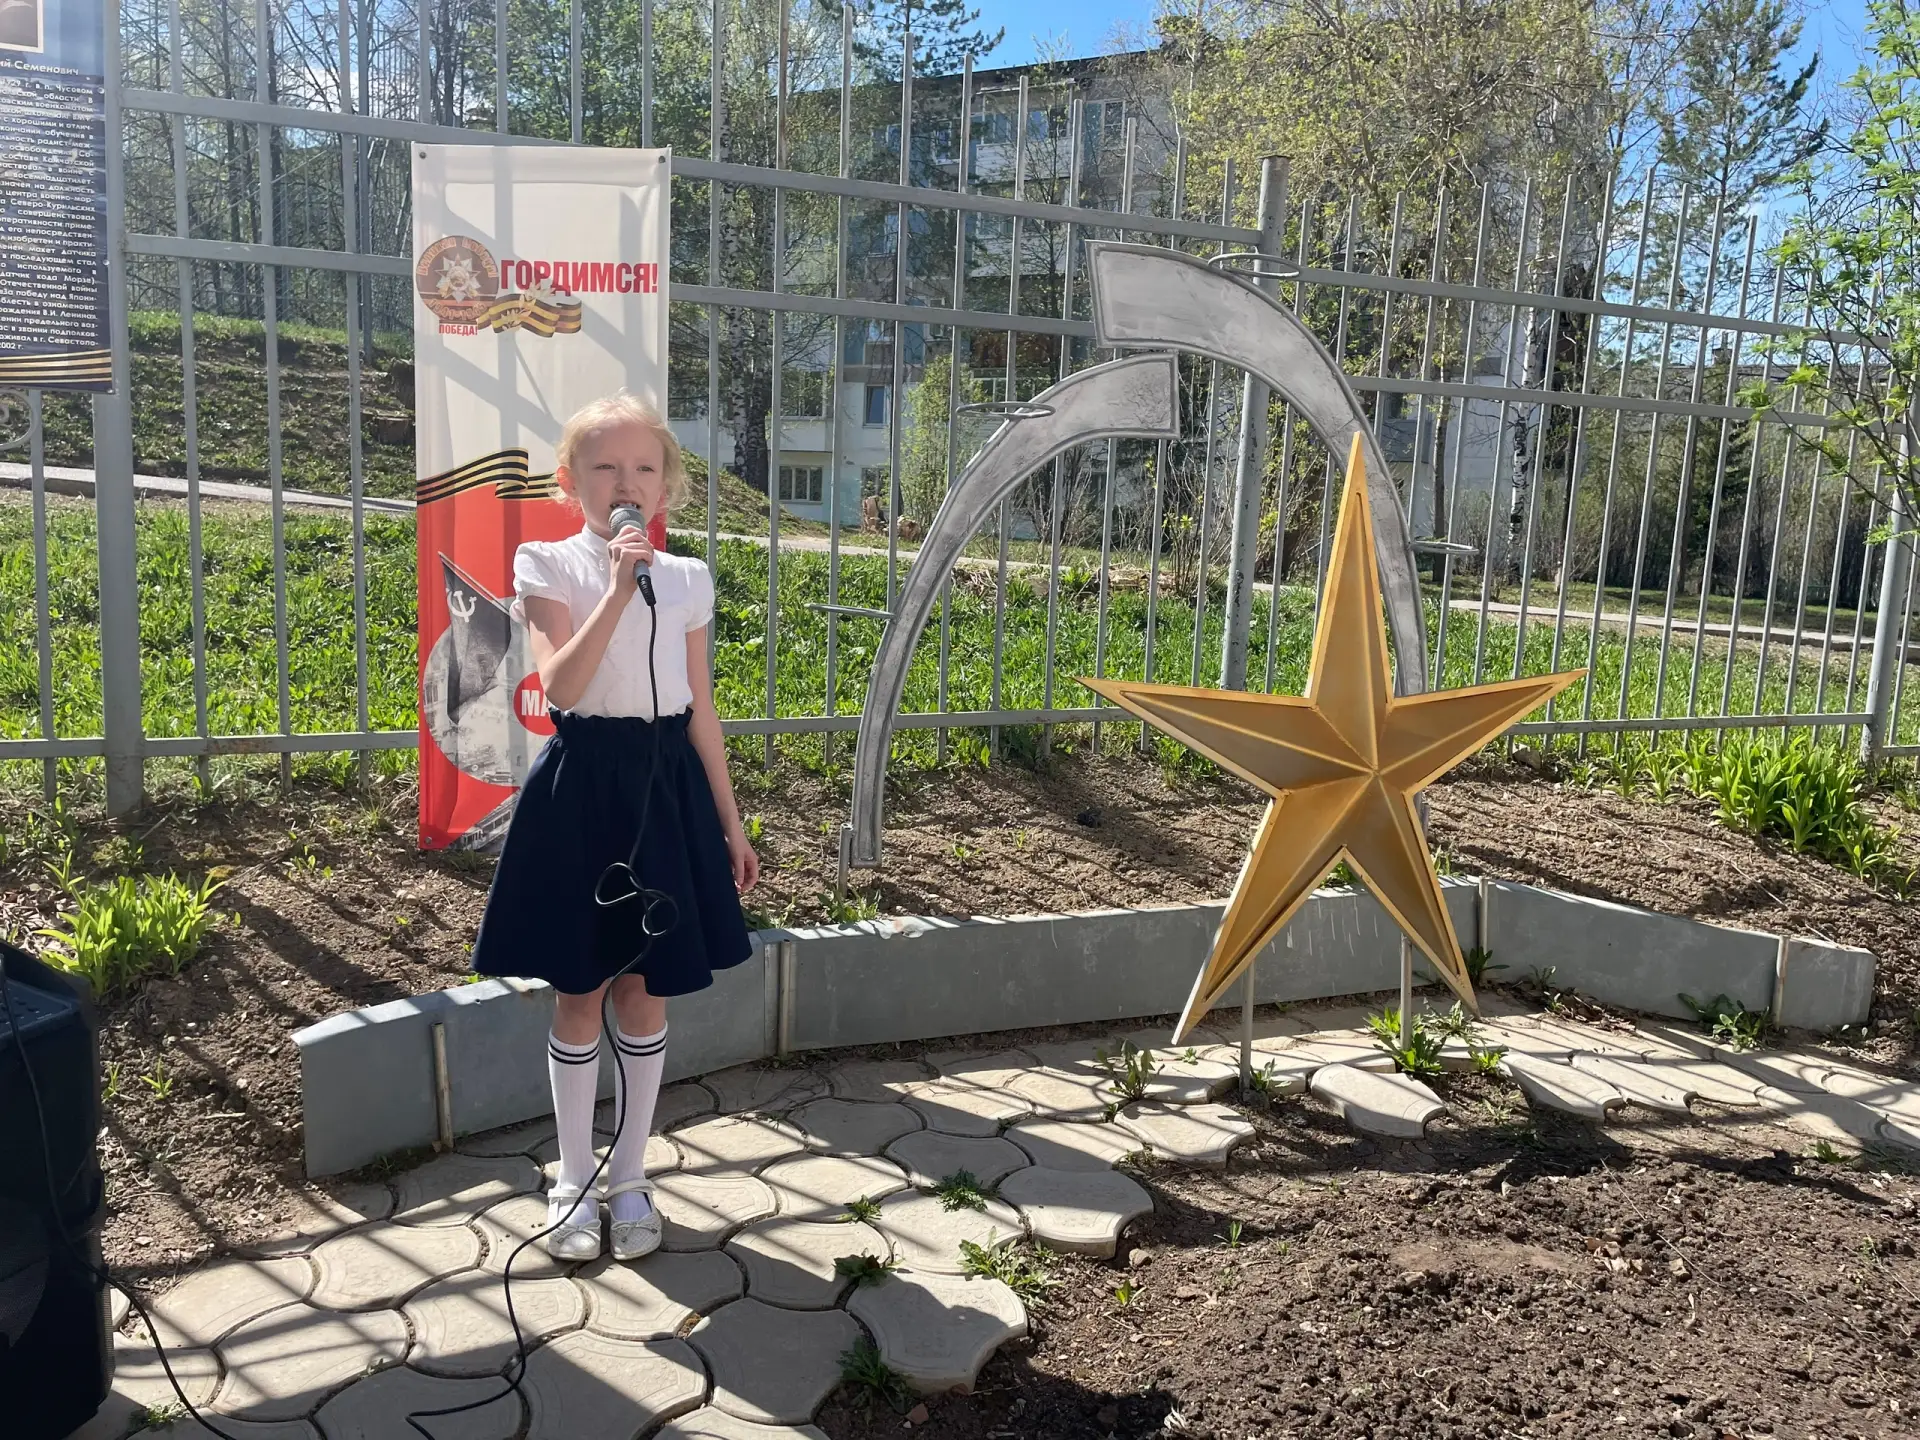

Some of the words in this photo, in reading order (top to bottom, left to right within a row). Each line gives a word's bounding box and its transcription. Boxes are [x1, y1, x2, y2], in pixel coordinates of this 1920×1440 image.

[14, 60, 79, 76] Семенович
[56, 84, 94, 95] Чусовом
[11, 118, 57, 128] хорошими
[45, 129, 85, 140] обучения
[6, 190, 38, 199] центра
[48, 184, 95, 195] должность
[10, 198, 96, 213] Северо-Курильских
[17, 208, 96, 221] совершенствовал
[64, 221, 96, 230] приме-
[25, 227, 96, 239] непосредствен-
[7, 234, 54, 245] изобретен
[62, 239, 96, 248] практи-
[28, 246, 56, 254] макет
[61, 248, 97, 258] датчика
[10, 253, 74, 265] последующем
[17, 262, 82, 275] используемого
[36, 273, 58, 281] кода
[500, 259, 659, 297] ГОРДИМСЯ!
[0, 278, 68, 291] Отечественной
[71, 284, 98, 293] войны
[15, 288, 48, 299] победу
[50, 292, 67, 300] над
[42, 301, 98, 312] ознаменова-
[23, 317, 80, 328] предельного
[50, 328, 98, 338] подполков-
[438, 324, 478, 336] ПОБЕДА!
[48, 336, 99, 347] Севастопо-
